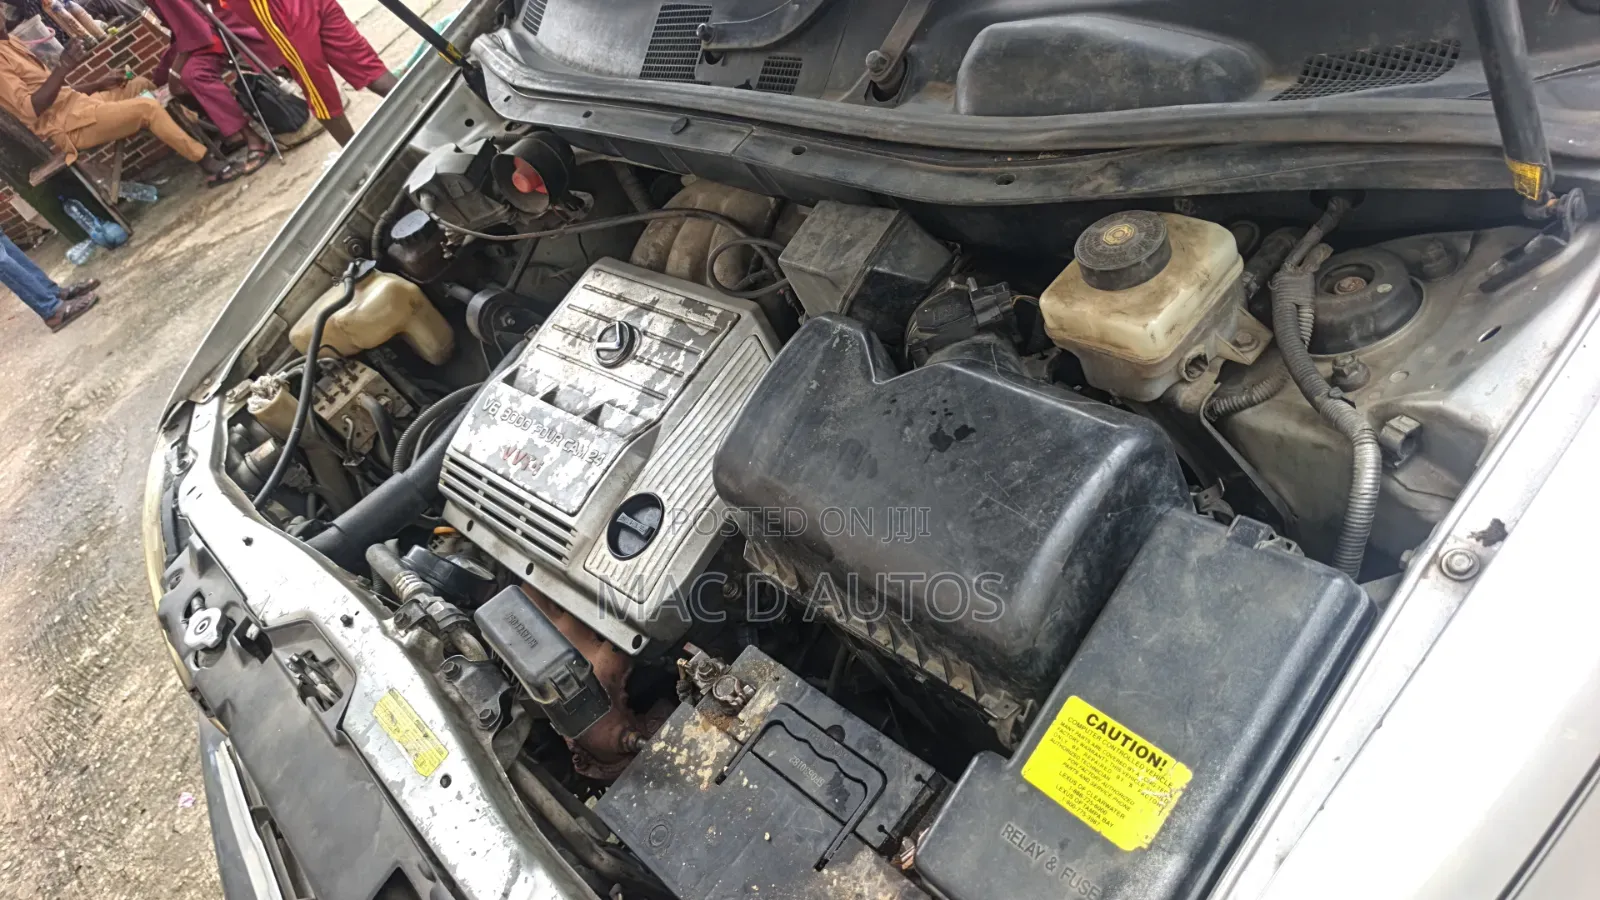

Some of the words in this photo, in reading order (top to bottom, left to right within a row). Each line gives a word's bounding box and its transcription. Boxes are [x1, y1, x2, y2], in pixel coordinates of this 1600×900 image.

[480, 396, 501, 417] V6
[499, 406, 534, 432] 3000
[530, 422, 564, 447] FOUR
[561, 436, 589, 459] CAM
[585, 447, 606, 468] 24
[1048, 737, 1081, 760] AUTHORIZED
[1079, 758, 1111, 781] TECHNICIAN
[1052, 731, 1068, 744] ONLY
[1082, 752, 1112, 774] REPAIRED
[1055, 726, 1080, 744] FACTORY
[1108, 761, 1122, 773] THIS
[1121, 770, 1145, 788] VEHICLE
[1059, 721, 1075, 733] MANY
[1074, 731, 1091, 744] PARTS
[1090, 741, 1102, 751] ARE
[1101, 749, 1127, 768] COVERED
[1066, 716, 1102, 741] COMPUTER
[1100, 738, 1145, 770] CONTROLLED
[1144, 766, 1173, 789] VEHICLE
[1084, 711, 1168, 771] CAUTION!
[1054, 783, 1074, 800] LEXUS
[1073, 797, 1082, 805] OF
[1081, 802, 1102, 819] TAMPA
[1101, 816, 1114, 828] BAY
[1057, 770, 1078, 786] LEXUS
[1077, 783, 1086, 792] OF
[1084, 789, 1126, 819] CLEARWATER
[1061, 761, 1079, 775] PARTS
[1077, 772, 1091, 783] AND
[1089, 780, 1112, 798] SERVICE
[1110, 795, 1131, 812] PHONE
[1066, 757, 1078, 767] FOR
[1077, 764, 1102, 783] FACTORY
[1100, 780, 1135, 806] AUTHORIZED
[999, 822, 1046, 861] RELAY
[1043, 854, 1060, 872] &
[1058, 866, 1101, 900] FUSE
